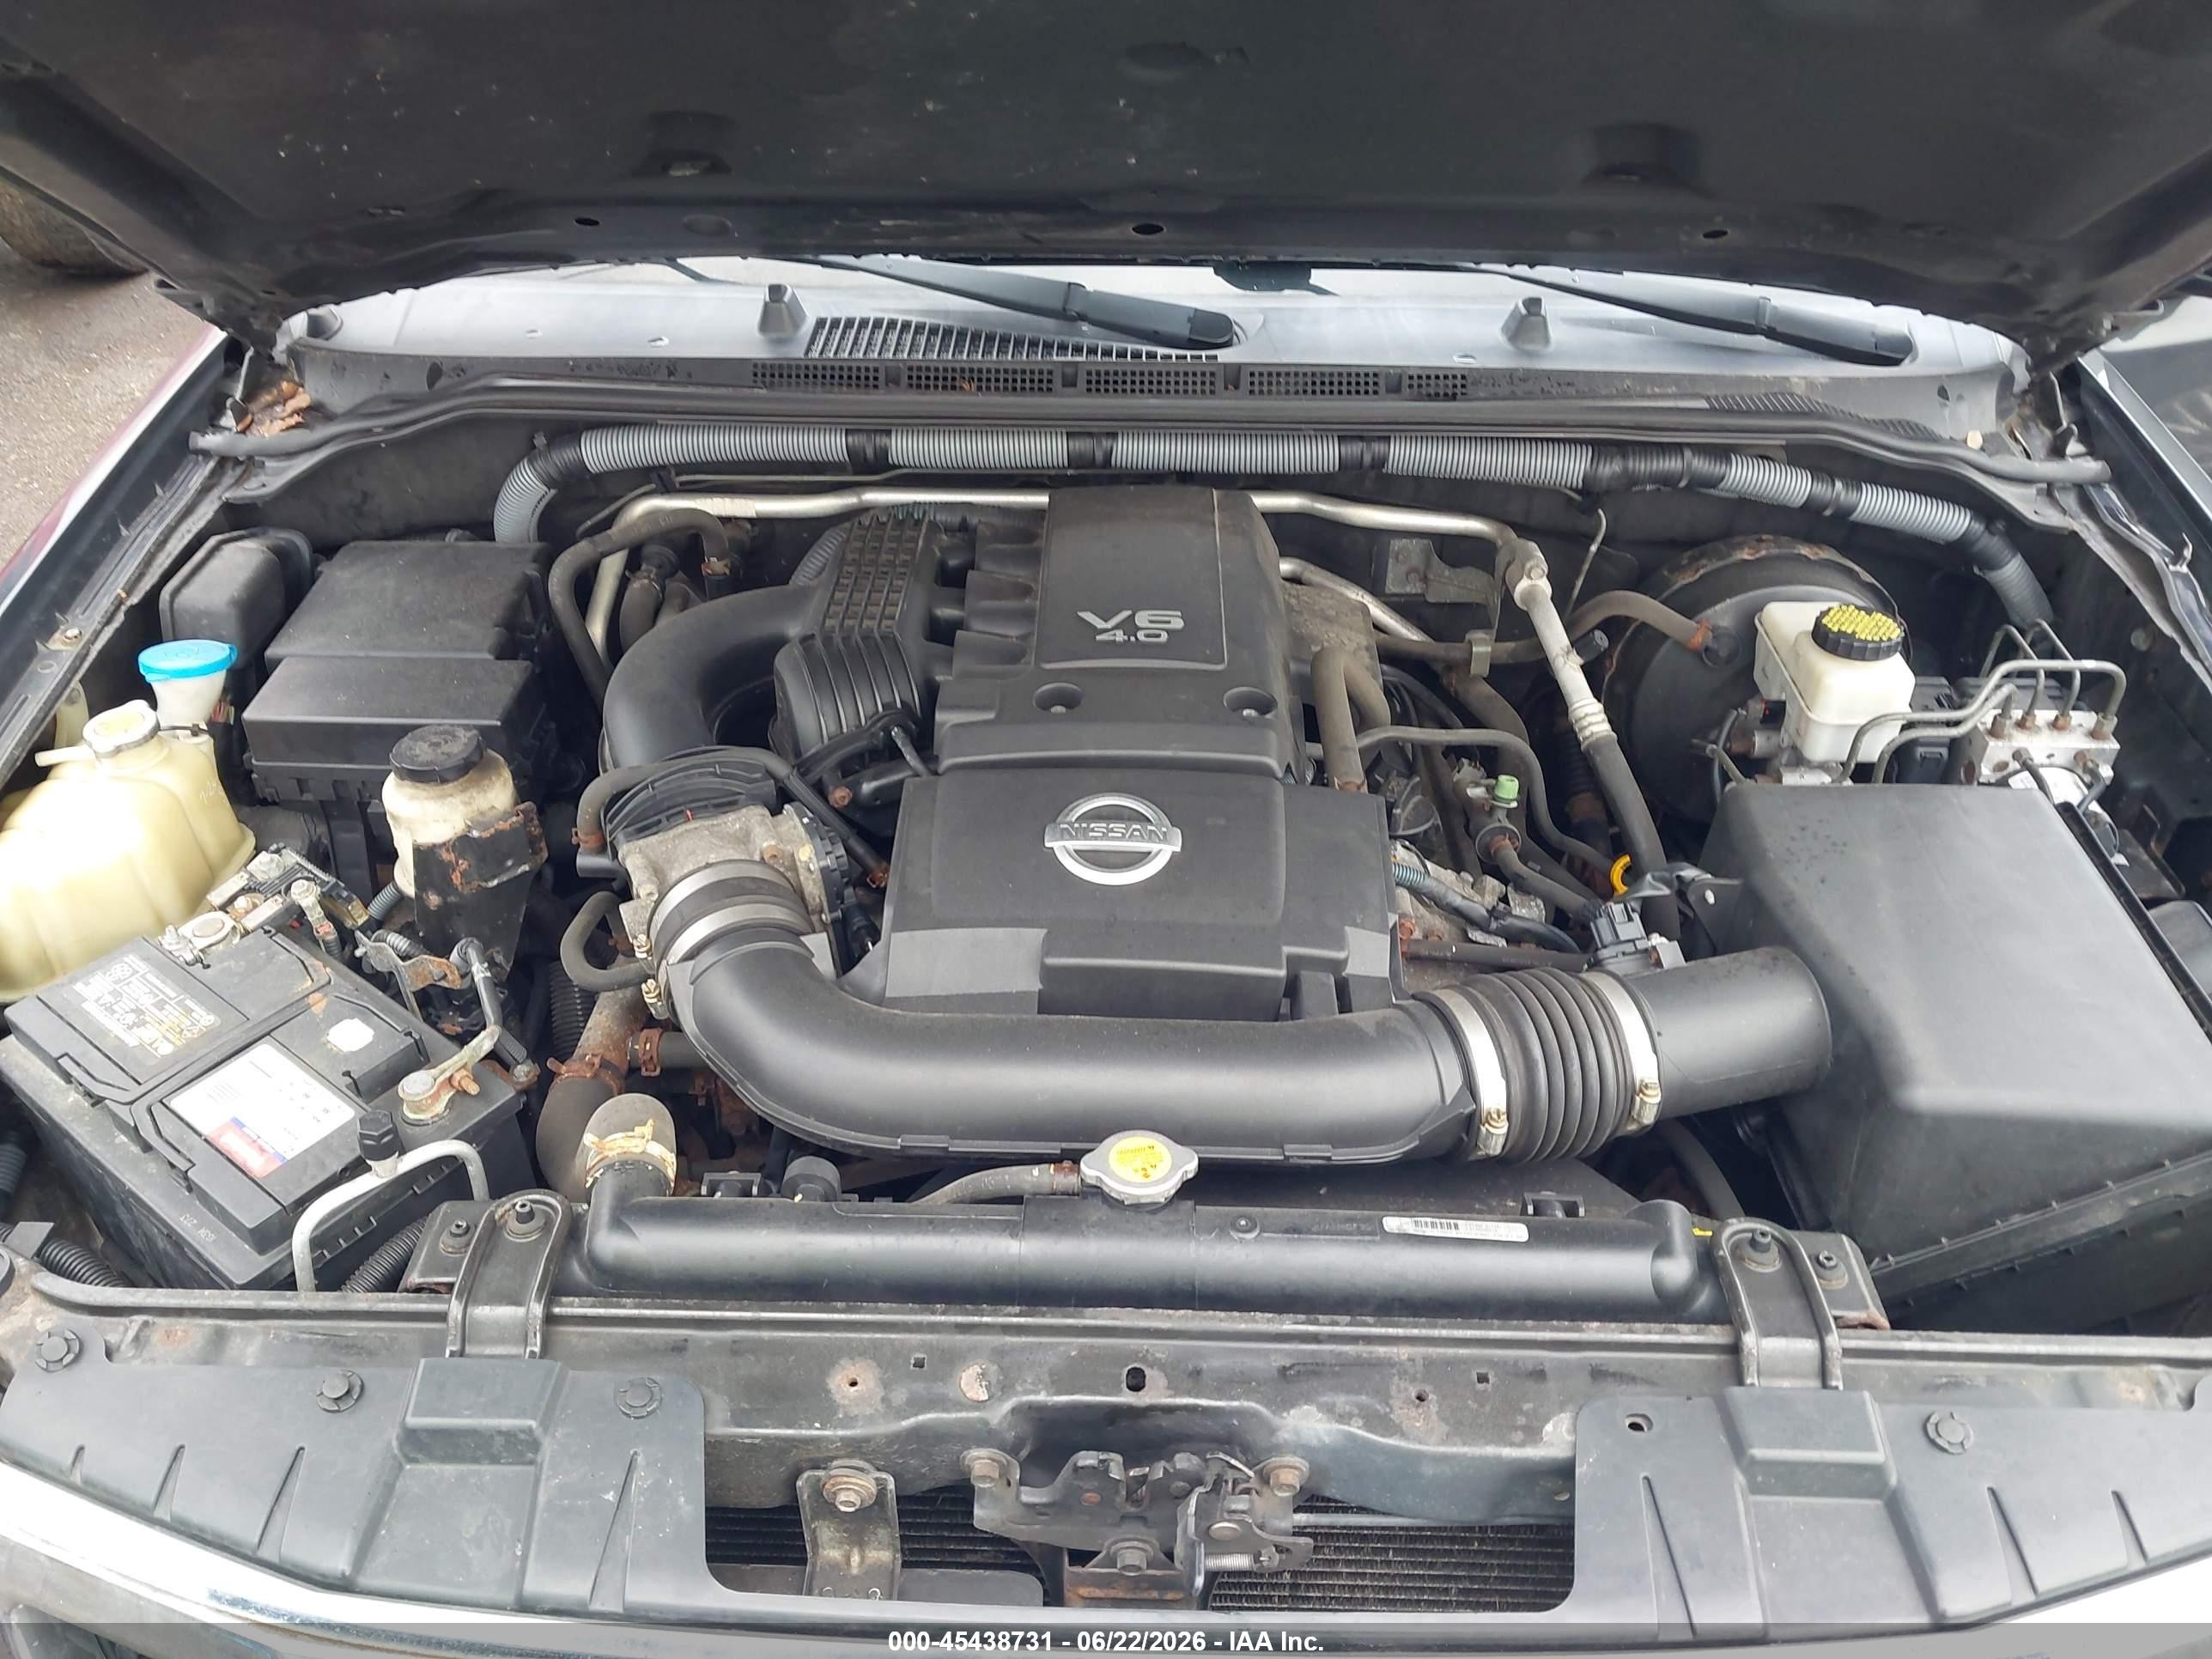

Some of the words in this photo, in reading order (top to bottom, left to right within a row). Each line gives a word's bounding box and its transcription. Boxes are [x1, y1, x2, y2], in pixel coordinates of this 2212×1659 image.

[1076, 609, 1185, 629] V6
[1095, 629, 1168, 642] 4.0
[1059, 822, 1169, 842] NISSAN
